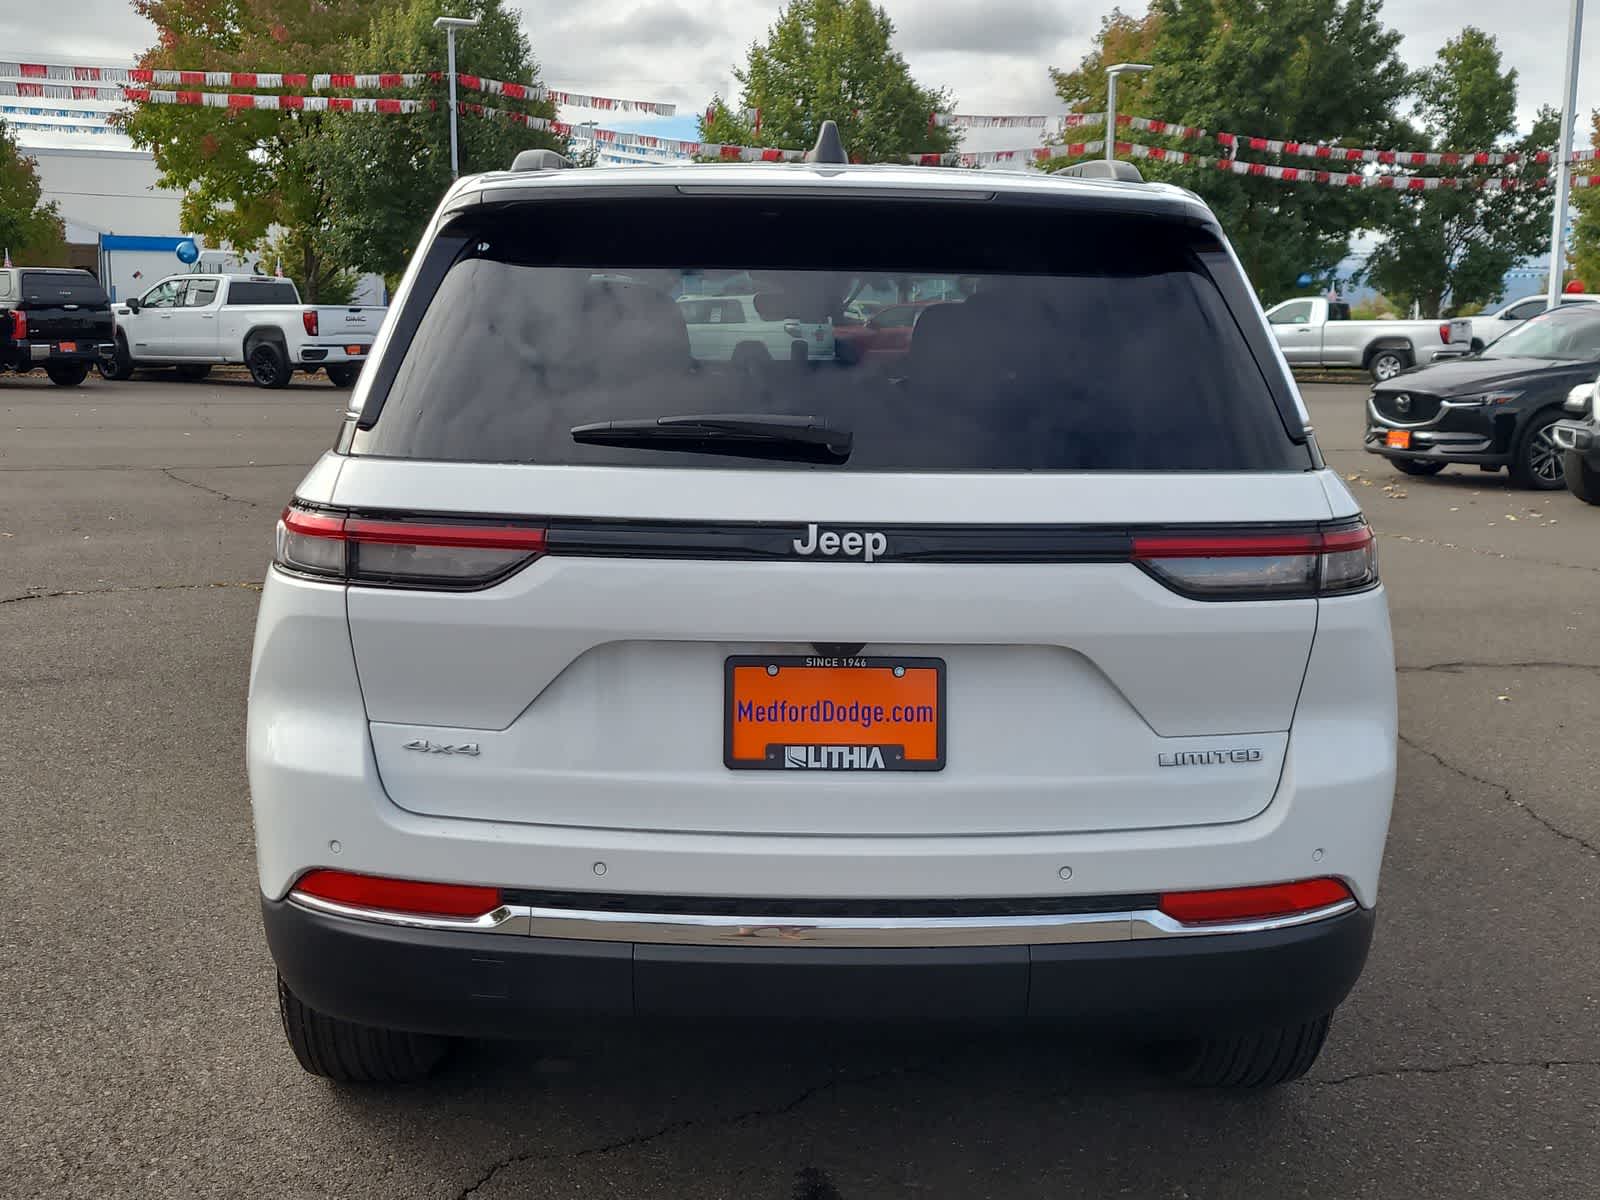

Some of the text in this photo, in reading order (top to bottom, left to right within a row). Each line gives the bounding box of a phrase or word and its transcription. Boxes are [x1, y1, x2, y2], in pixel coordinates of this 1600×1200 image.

[793, 523, 887, 562] Jeep
[806, 658, 867, 668] SINCE 1946
[737, 700, 933, 728] MedfordDodge.com
[402, 740, 480, 756] 4x4
[807, 746, 885, 768] LITHIA
[1158, 748, 1262, 767] LIMITED
